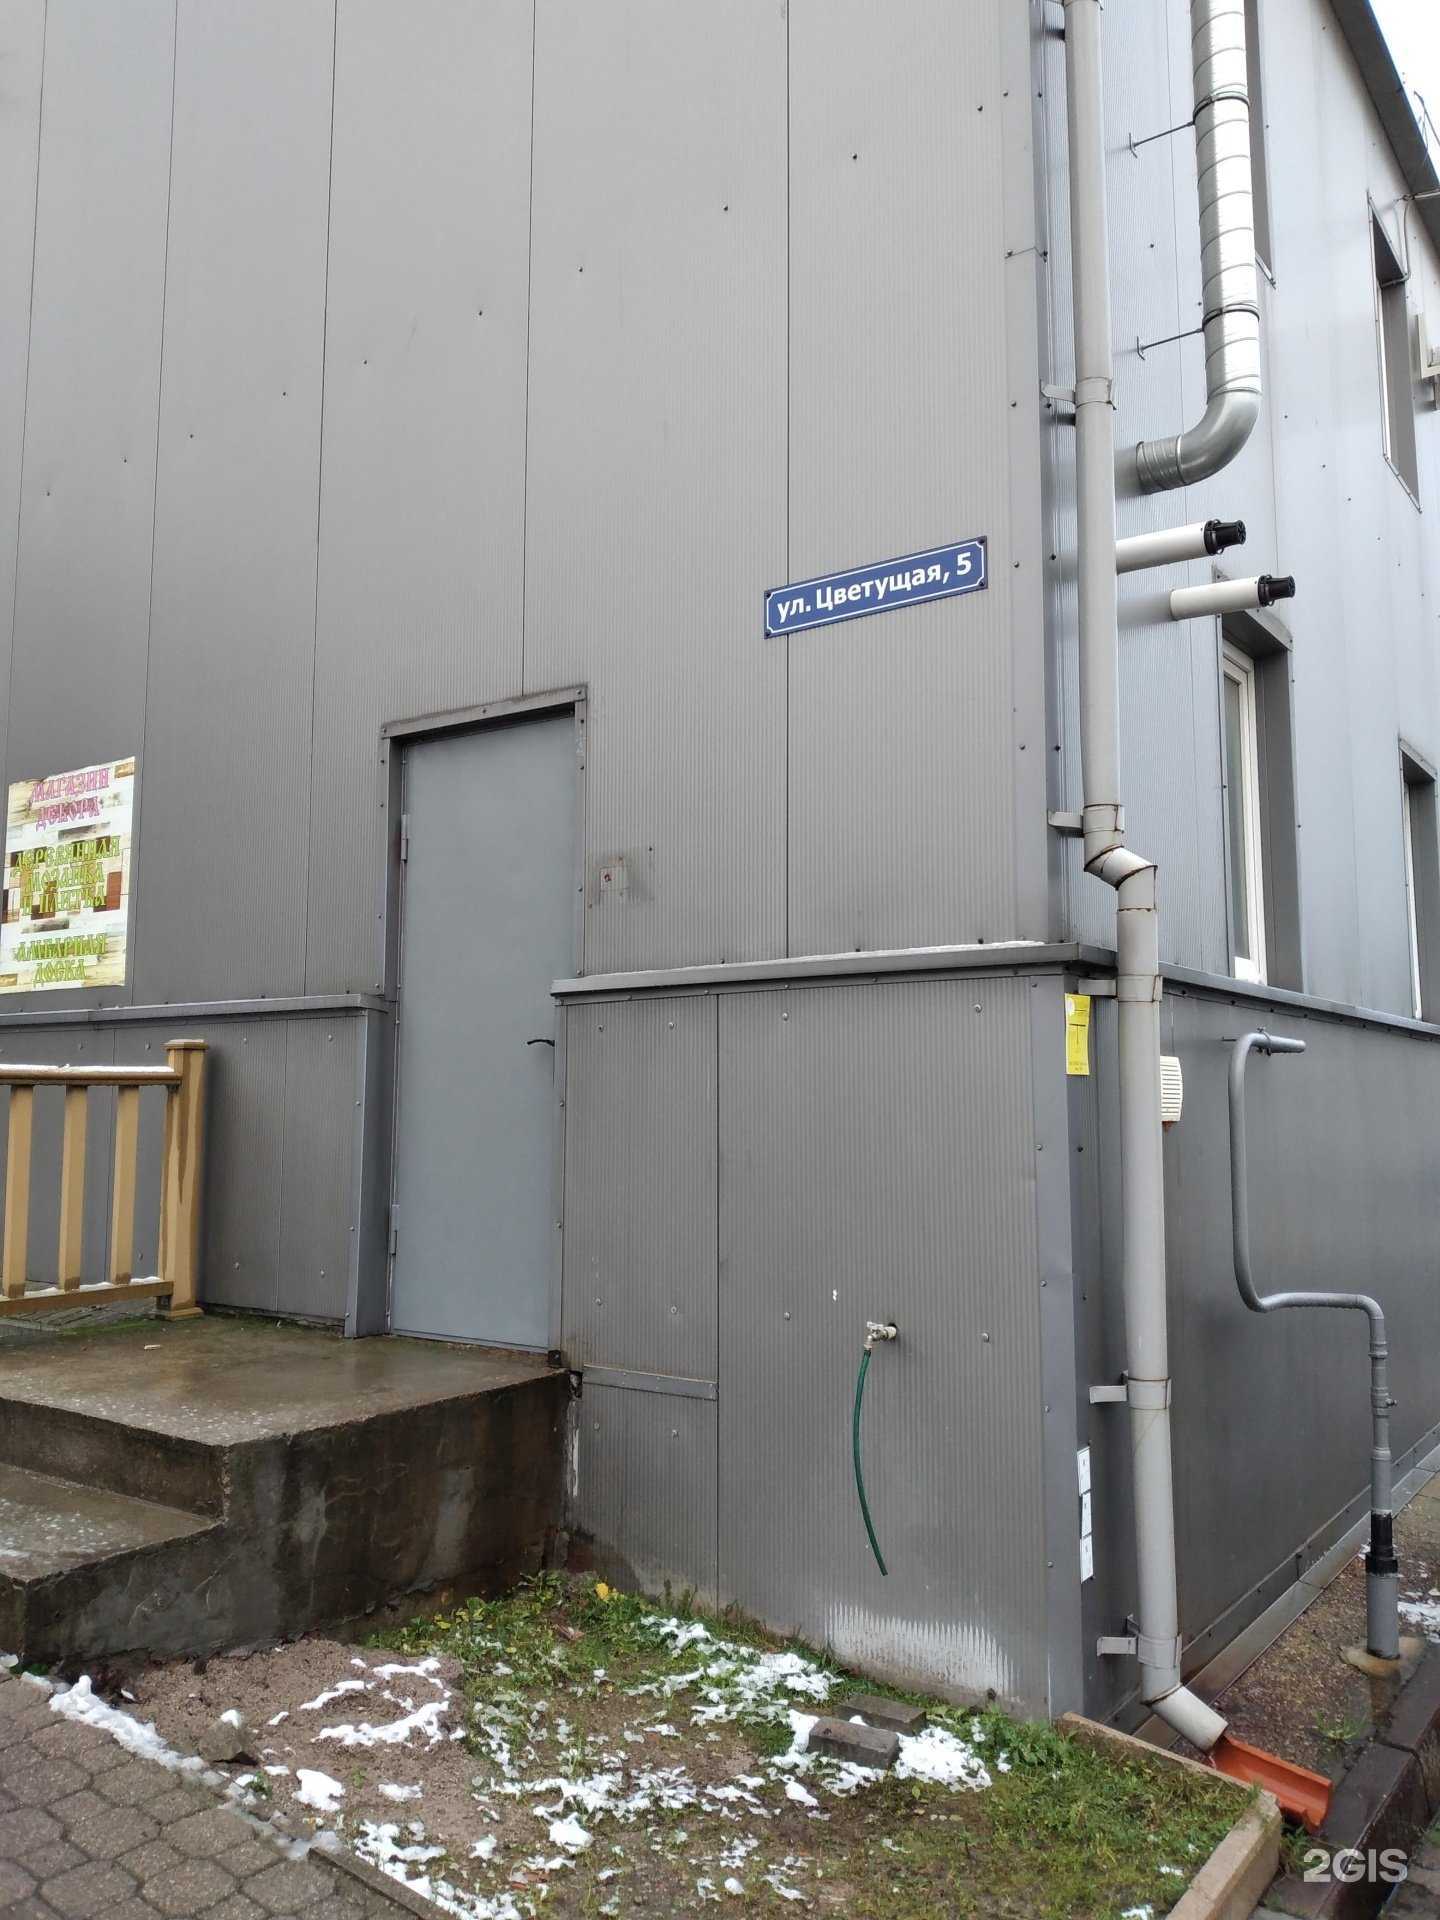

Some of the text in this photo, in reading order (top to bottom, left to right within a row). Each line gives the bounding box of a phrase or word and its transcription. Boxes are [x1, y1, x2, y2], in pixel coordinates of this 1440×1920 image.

[777, 552, 972, 624] ул. Цветущая, 5
[31, 767, 110, 803] МАГАЗИН
[36, 796, 101, 830] ДЕКОРА
[10, 836, 121, 877] ДЕРЕВЯННАЯ
[32, 959, 87, 987] ДОСКА
